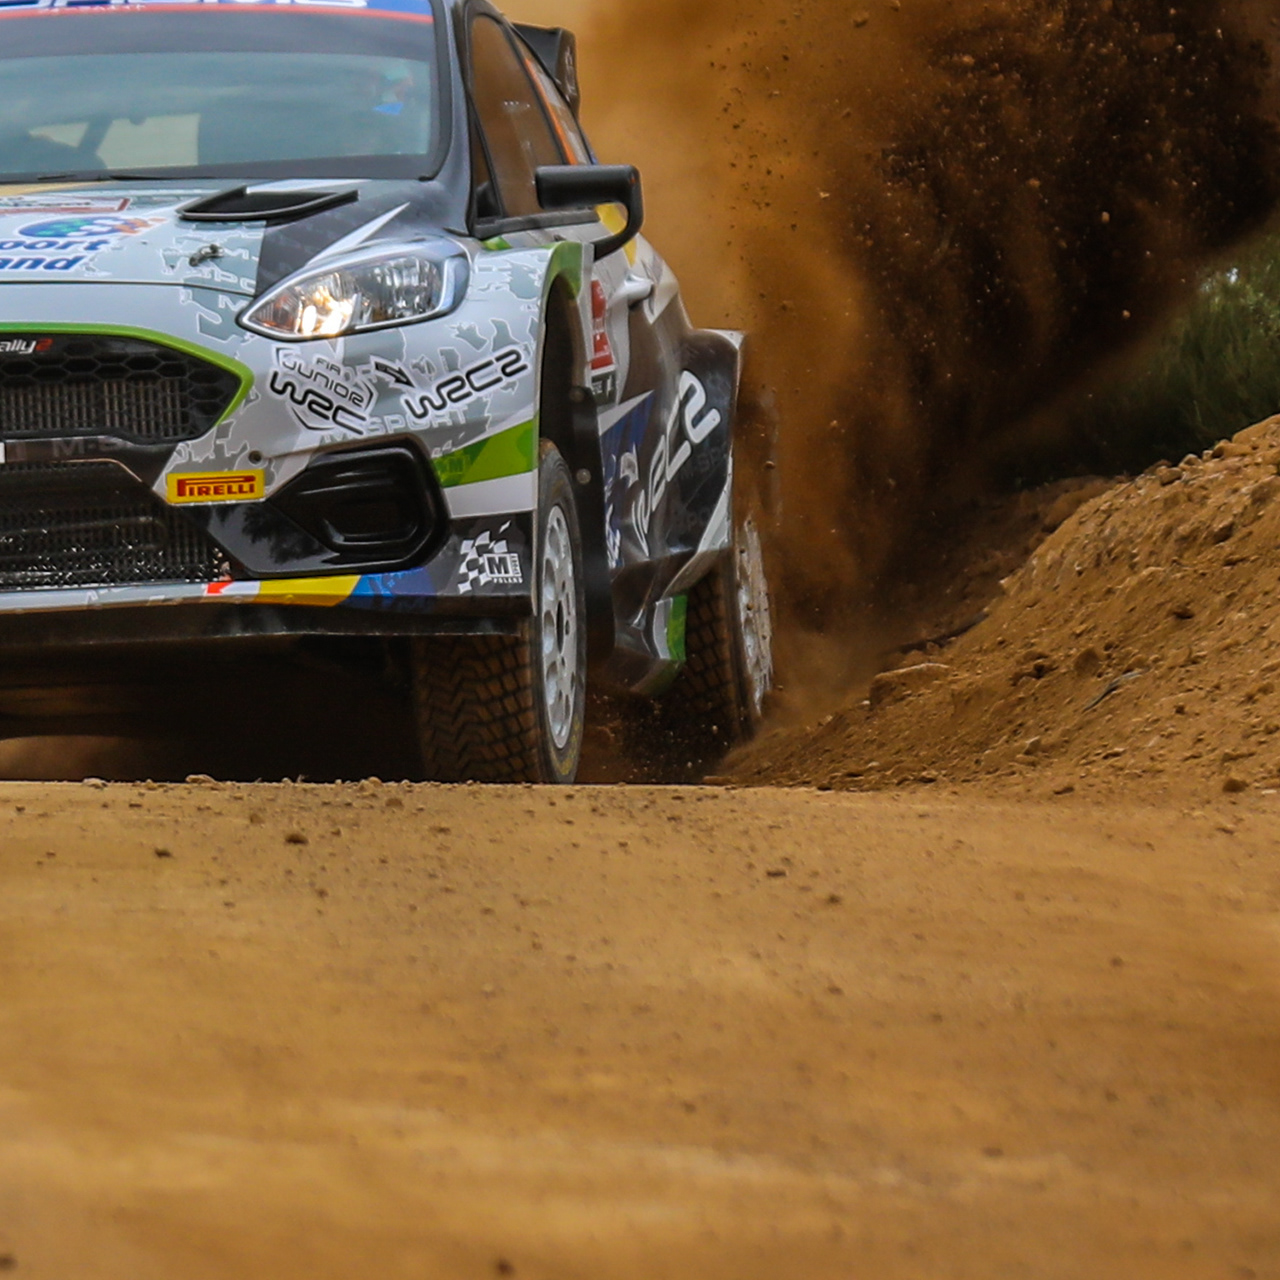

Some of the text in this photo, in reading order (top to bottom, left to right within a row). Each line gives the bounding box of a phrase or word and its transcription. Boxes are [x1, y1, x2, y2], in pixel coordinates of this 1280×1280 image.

[281, 357, 365, 407] JUNIOR
[316, 357, 341, 376] FIA
[404, 348, 529, 419] WRC2
[269, 371, 367, 435] WRC
[176, 475, 257, 497] PIRELLI
[486, 556, 511, 575] M
